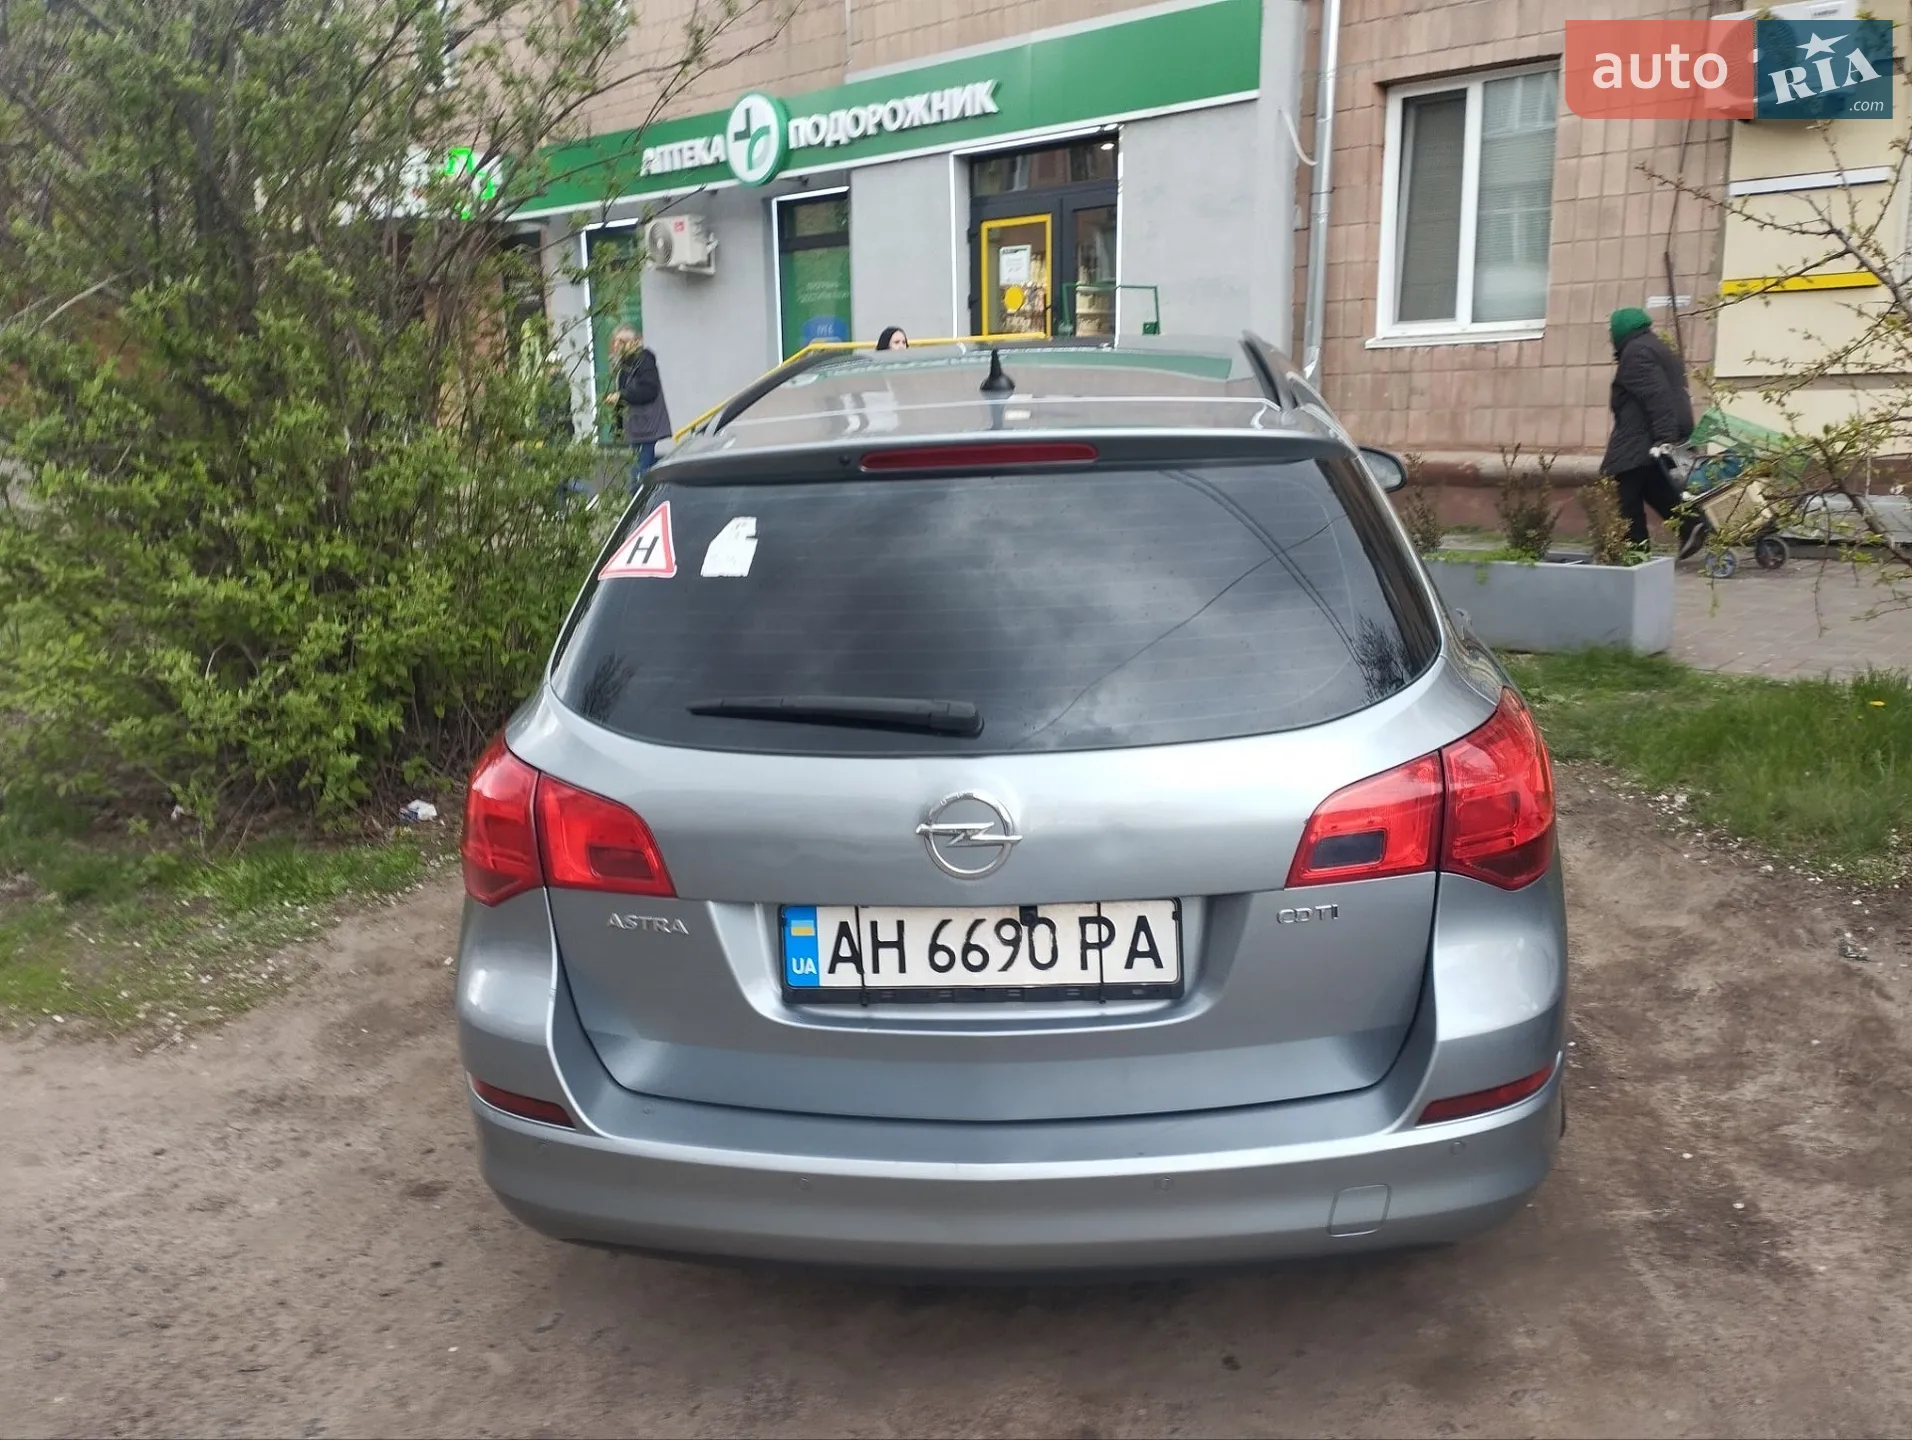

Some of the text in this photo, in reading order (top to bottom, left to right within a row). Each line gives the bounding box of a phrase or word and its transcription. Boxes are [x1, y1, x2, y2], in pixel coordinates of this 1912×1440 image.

[640, 79, 1000, 176] АПТЕКА ПОДОРОЖНИК
[607, 912, 690, 935] ASTRA
[1277, 903, 1339, 924] CDTI
[928, 916, 1059, 973] 6690
[792, 957, 817, 974] UA
